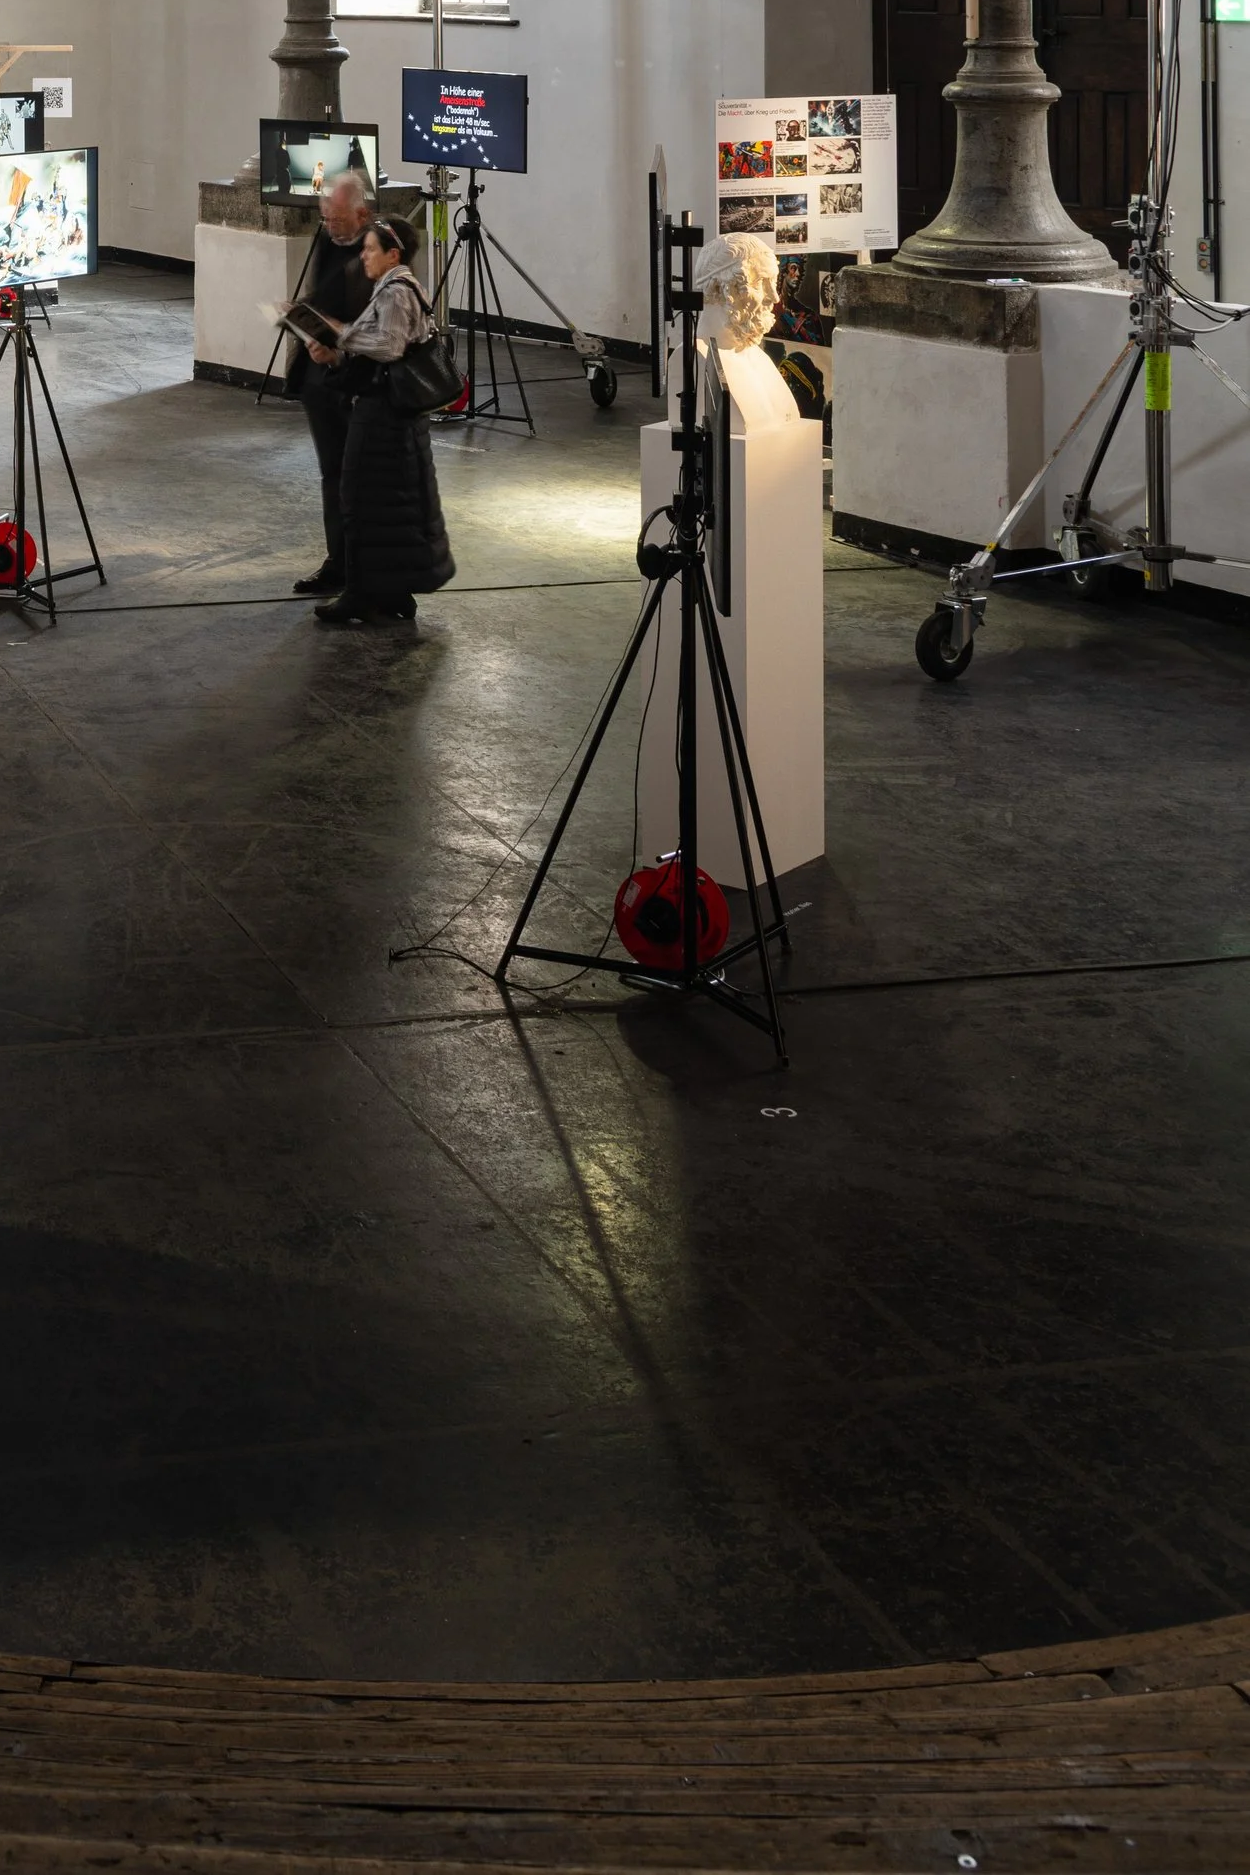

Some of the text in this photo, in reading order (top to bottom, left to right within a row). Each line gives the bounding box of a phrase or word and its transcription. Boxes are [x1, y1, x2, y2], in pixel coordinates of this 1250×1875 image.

[440, 85, 484, 97] In Höhe einer
[441, 115, 451, 124] das
[452, 116, 465, 125] Licht
[457, 125, 465, 134] als
[466, 126, 473, 135] im
